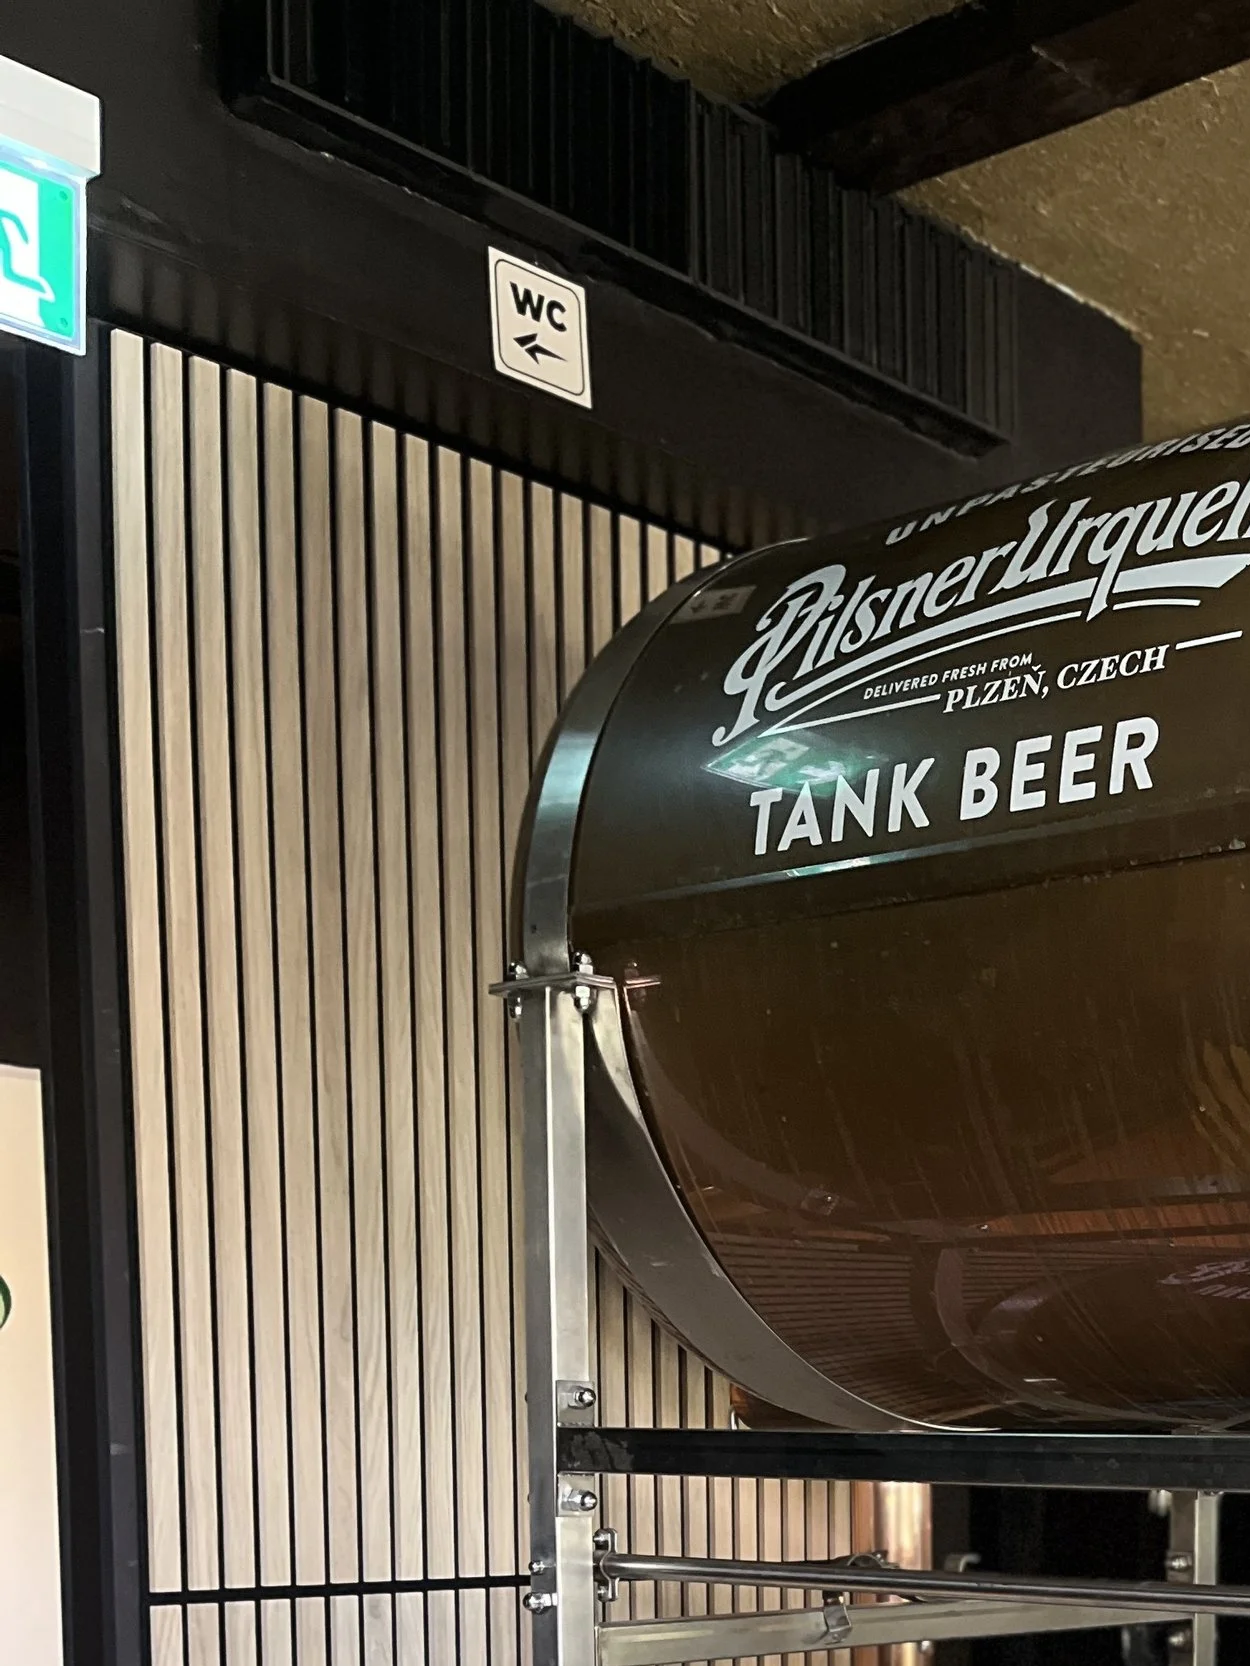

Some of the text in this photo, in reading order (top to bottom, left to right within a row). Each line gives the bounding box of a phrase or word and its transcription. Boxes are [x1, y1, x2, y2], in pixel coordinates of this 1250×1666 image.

[510, 281, 567, 332] WC
[712, 537, 1018, 747] Pilsner
[1057, 644, 1170, 690] CZECH
[863, 652, 1033, 700] DELIVERED FRESH FROM
[749, 716, 1160, 855] TANK BEER
